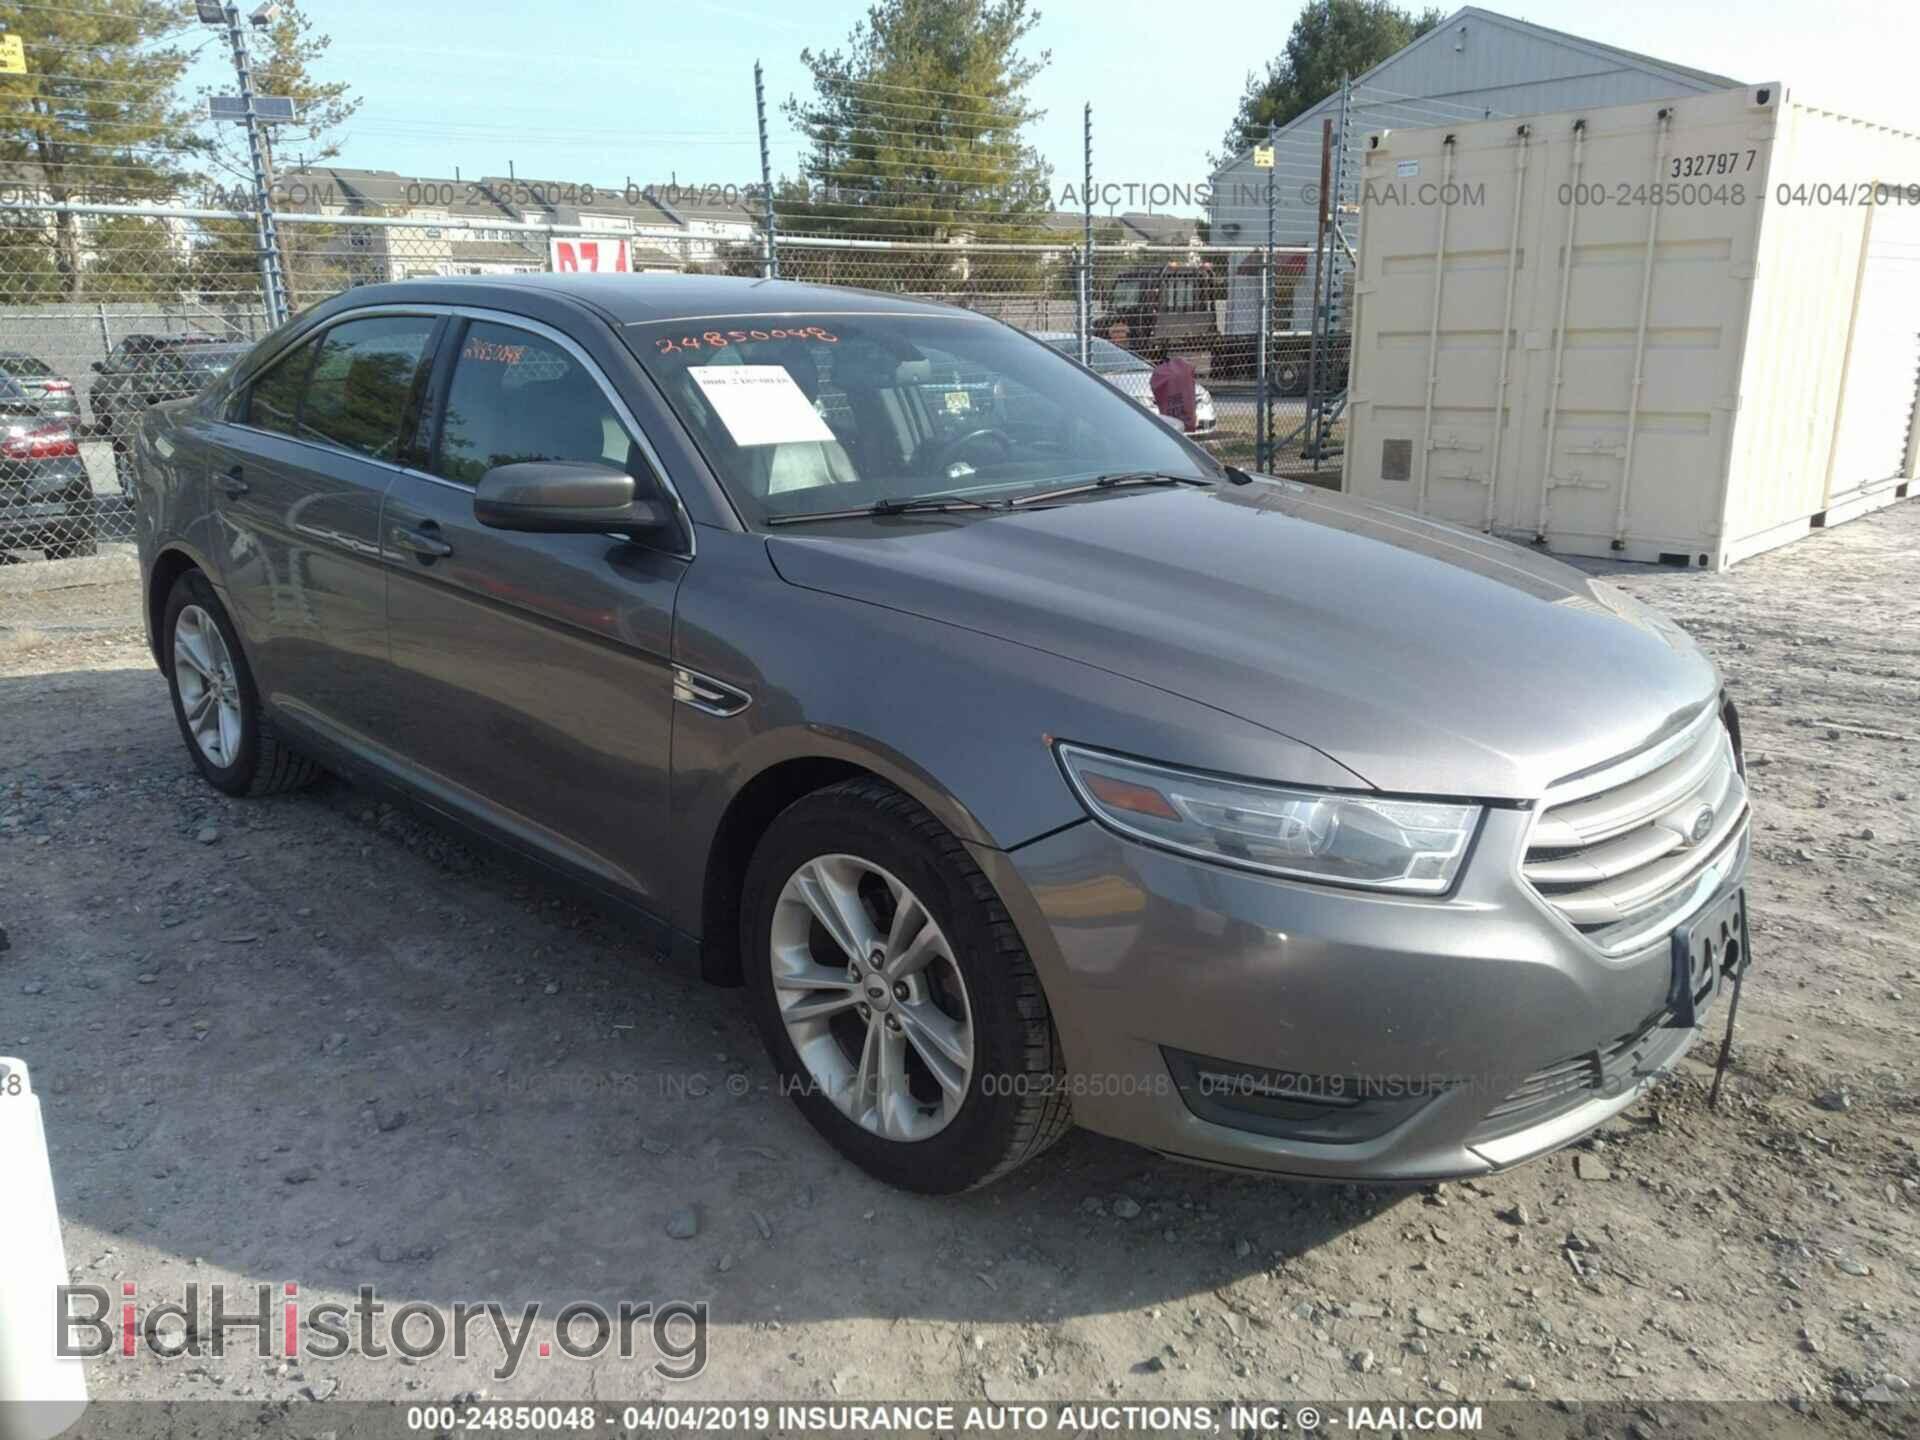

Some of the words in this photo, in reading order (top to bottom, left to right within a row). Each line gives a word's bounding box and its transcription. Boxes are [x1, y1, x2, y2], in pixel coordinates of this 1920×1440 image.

[1671, 153, 1738, 178] 332797
[1746, 150, 1757, 171] 7
[656, 327, 837, 352] 24850048
